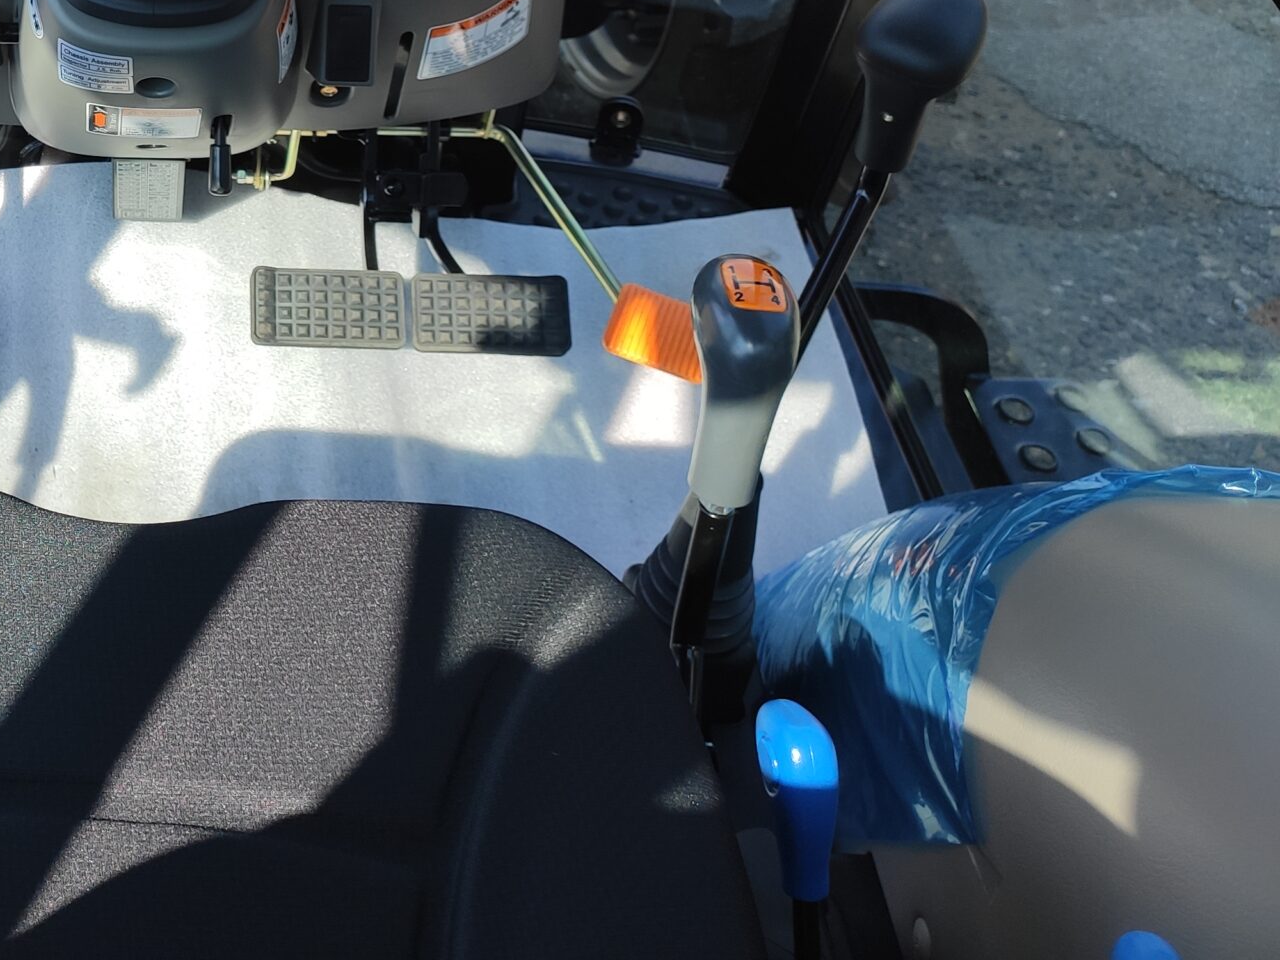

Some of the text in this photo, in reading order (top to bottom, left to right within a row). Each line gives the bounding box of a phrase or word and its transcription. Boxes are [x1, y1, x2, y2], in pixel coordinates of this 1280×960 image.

[63, 48, 126, 68] Chassis Assembly
[62, 68, 127, 86] Tuning Adjustment
[734, 291, 745, 302] 2
